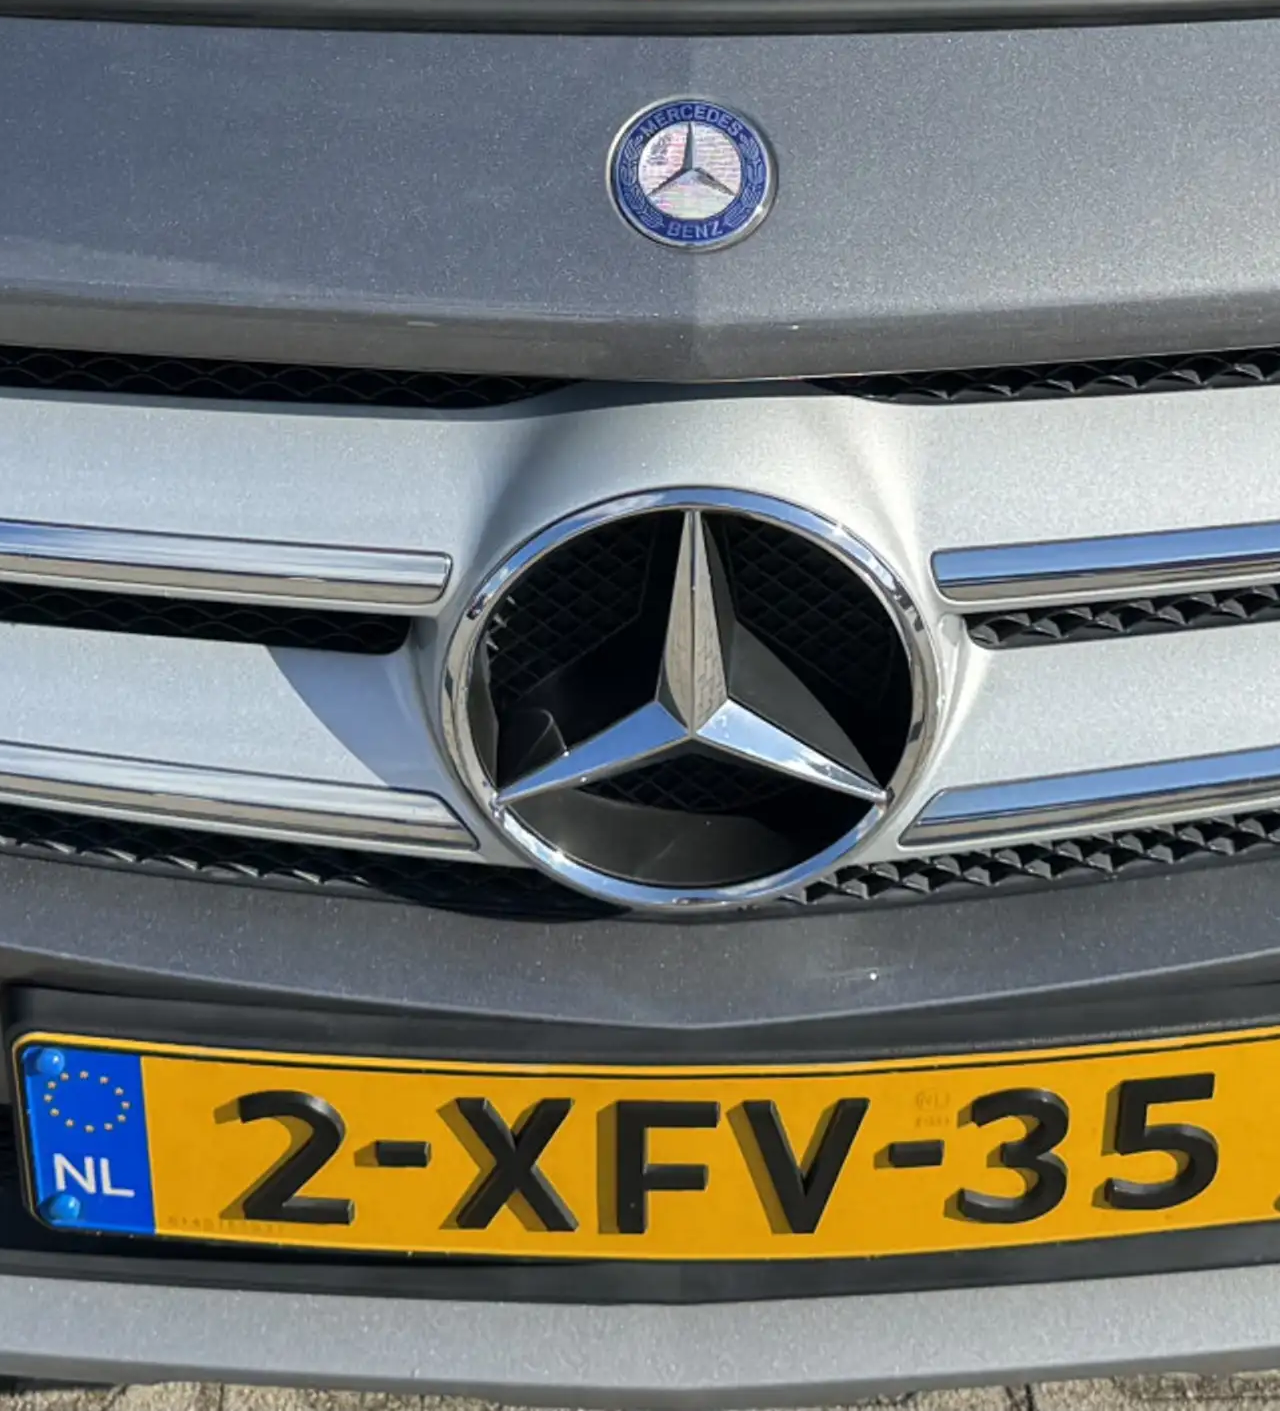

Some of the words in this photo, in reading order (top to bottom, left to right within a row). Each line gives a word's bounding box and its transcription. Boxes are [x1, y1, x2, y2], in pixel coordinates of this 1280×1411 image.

[642, 105, 743, 138] MERCEDES
[665, 220, 723, 239] BENZ
[234, 1074, 1219, 1234] 2-XFV-35
[52, 1152, 136, 1198] NL
